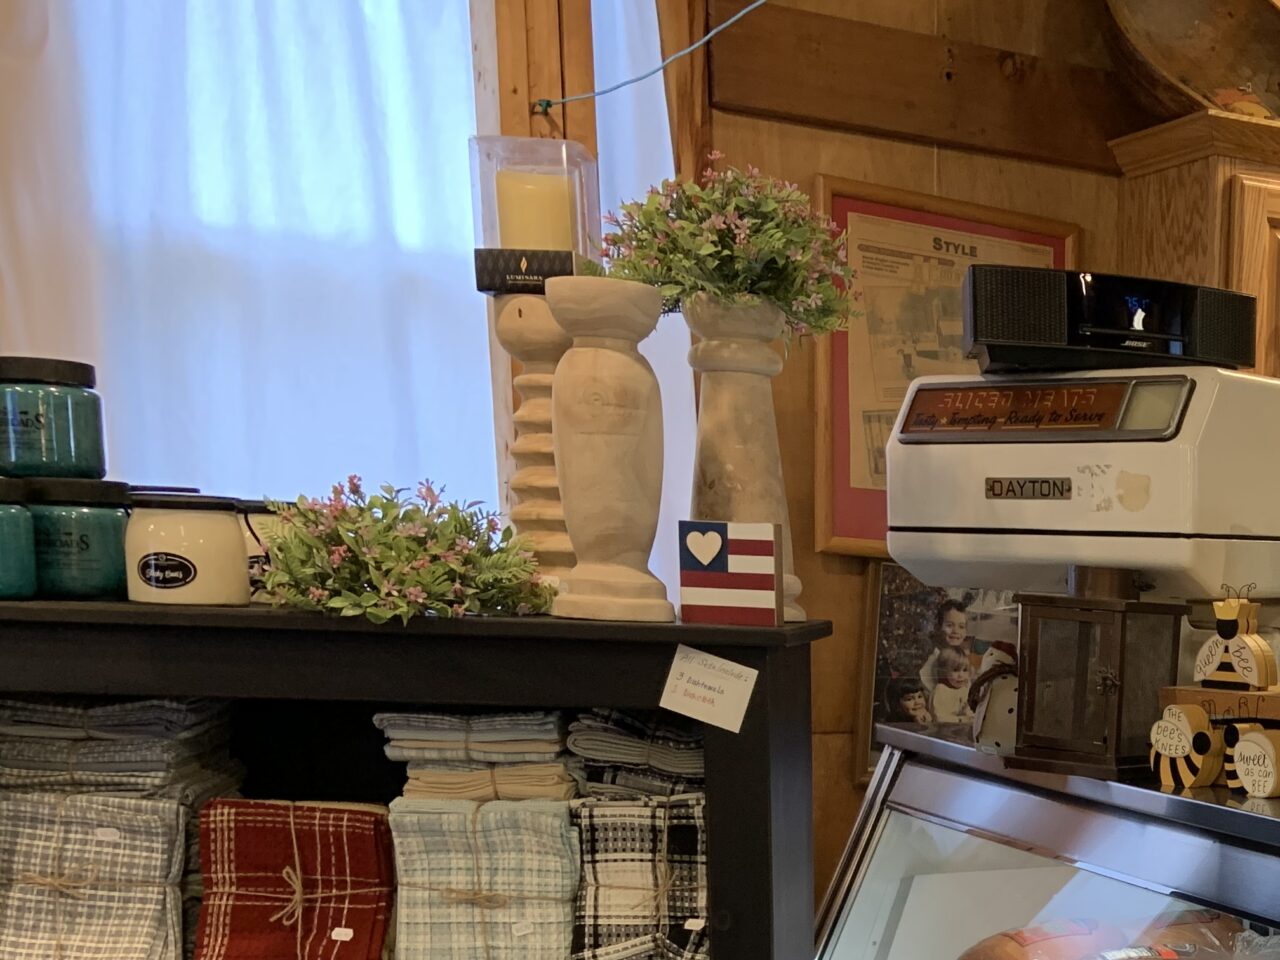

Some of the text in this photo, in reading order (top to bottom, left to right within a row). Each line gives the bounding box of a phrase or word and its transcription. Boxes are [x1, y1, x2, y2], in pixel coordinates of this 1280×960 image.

[932, 236, 978, 257] STYLE
[948, 408, 998, 430] Tempting
[1004, 405, 1044, 428] Ready
[1048, 408, 1061, 418] to
[1065, 406, 1106, 423] Serve
[991, 479, 1066, 497] DAYTON
[1195, 638, 1253, 678] queen bee
[676, 671, 685, 681] 3
[1168, 708, 1183, 722] THE
[1156, 723, 1183, 742] bee's
[1155, 737, 1187, 755] KNEES
[1236, 750, 1269, 769] sweet
[1244, 768, 1273, 778] as can
[1251, 781, 1268, 794] BEE
